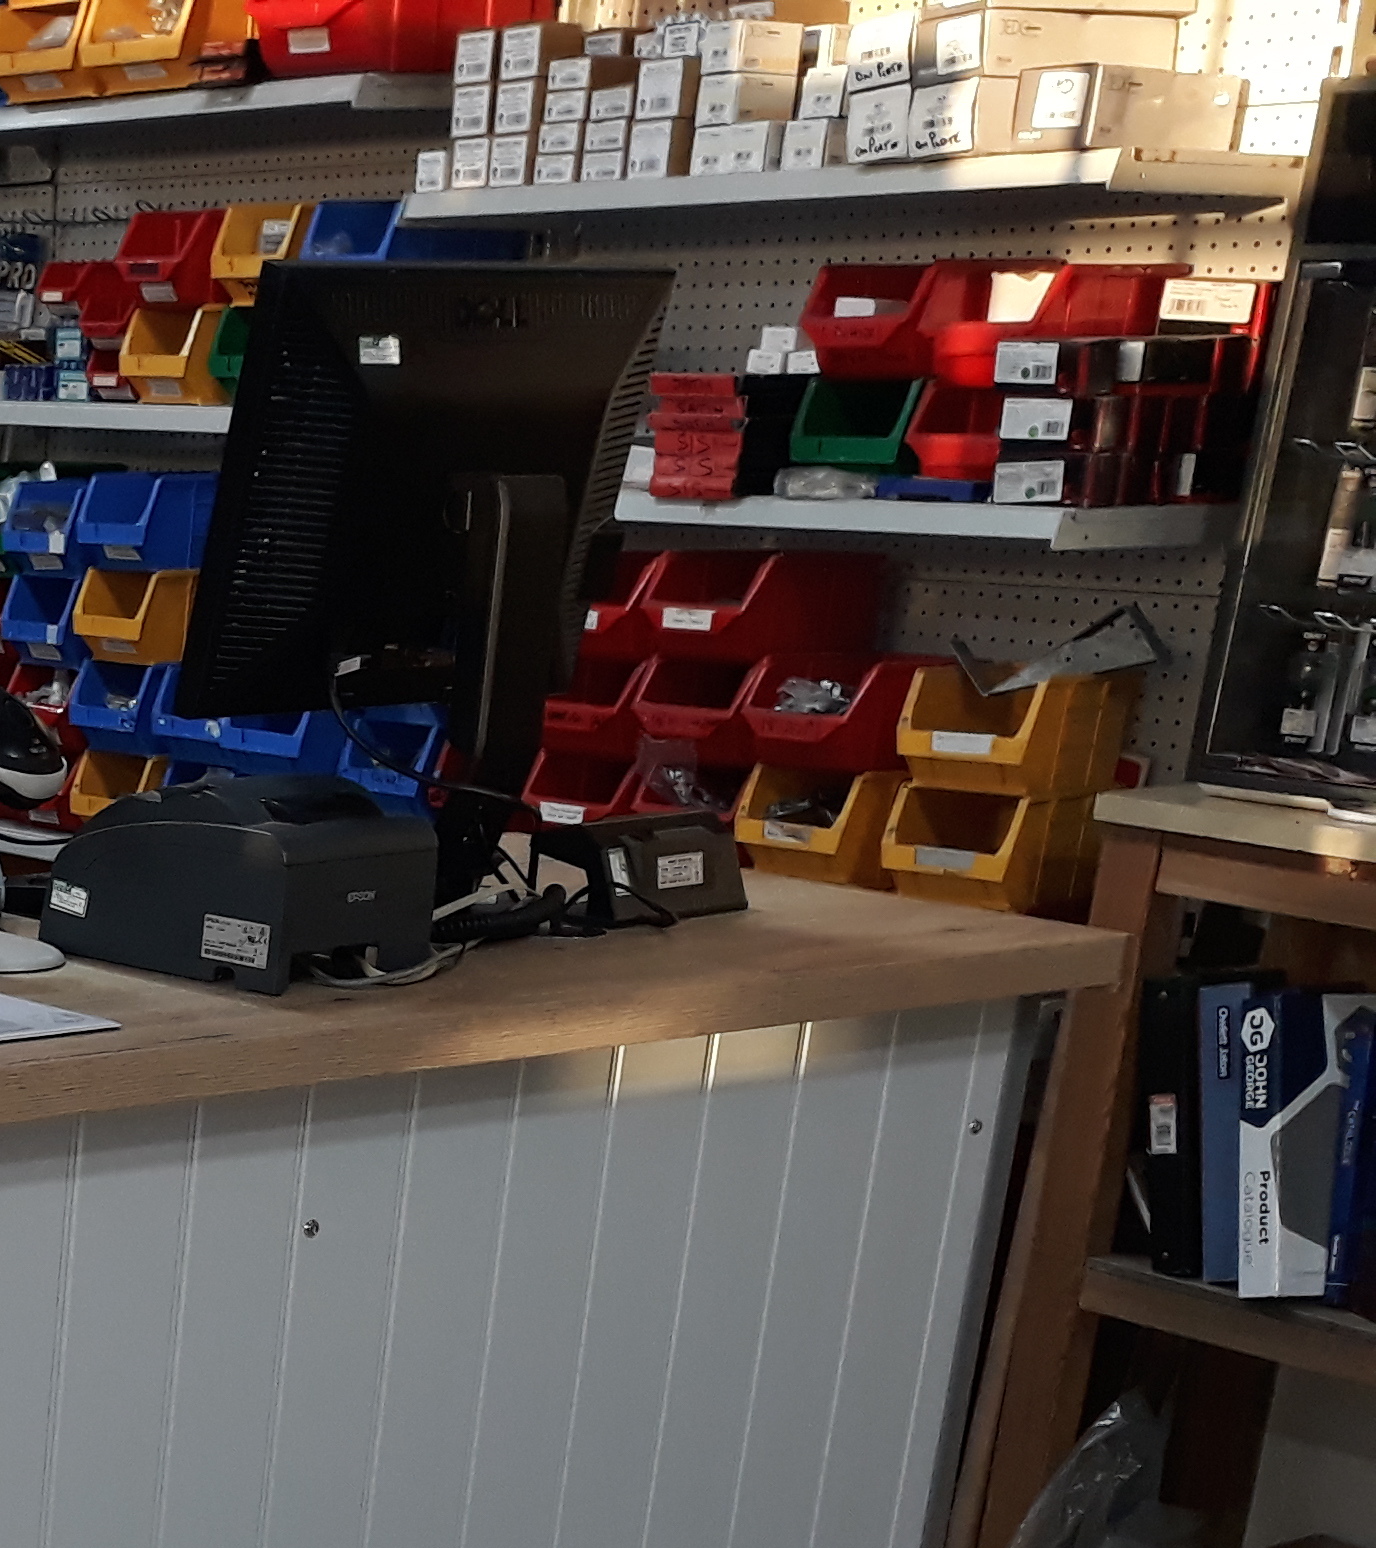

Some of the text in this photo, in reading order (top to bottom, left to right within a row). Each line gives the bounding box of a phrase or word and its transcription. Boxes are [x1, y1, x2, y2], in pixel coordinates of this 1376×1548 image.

[1245, 1054, 1255, 1110] GEORGE
[1255, 1053, 1268, 1109] JOHN
[1242, 1171, 1256, 1267] Catalogue
[1258, 1170, 1271, 1246] Product
